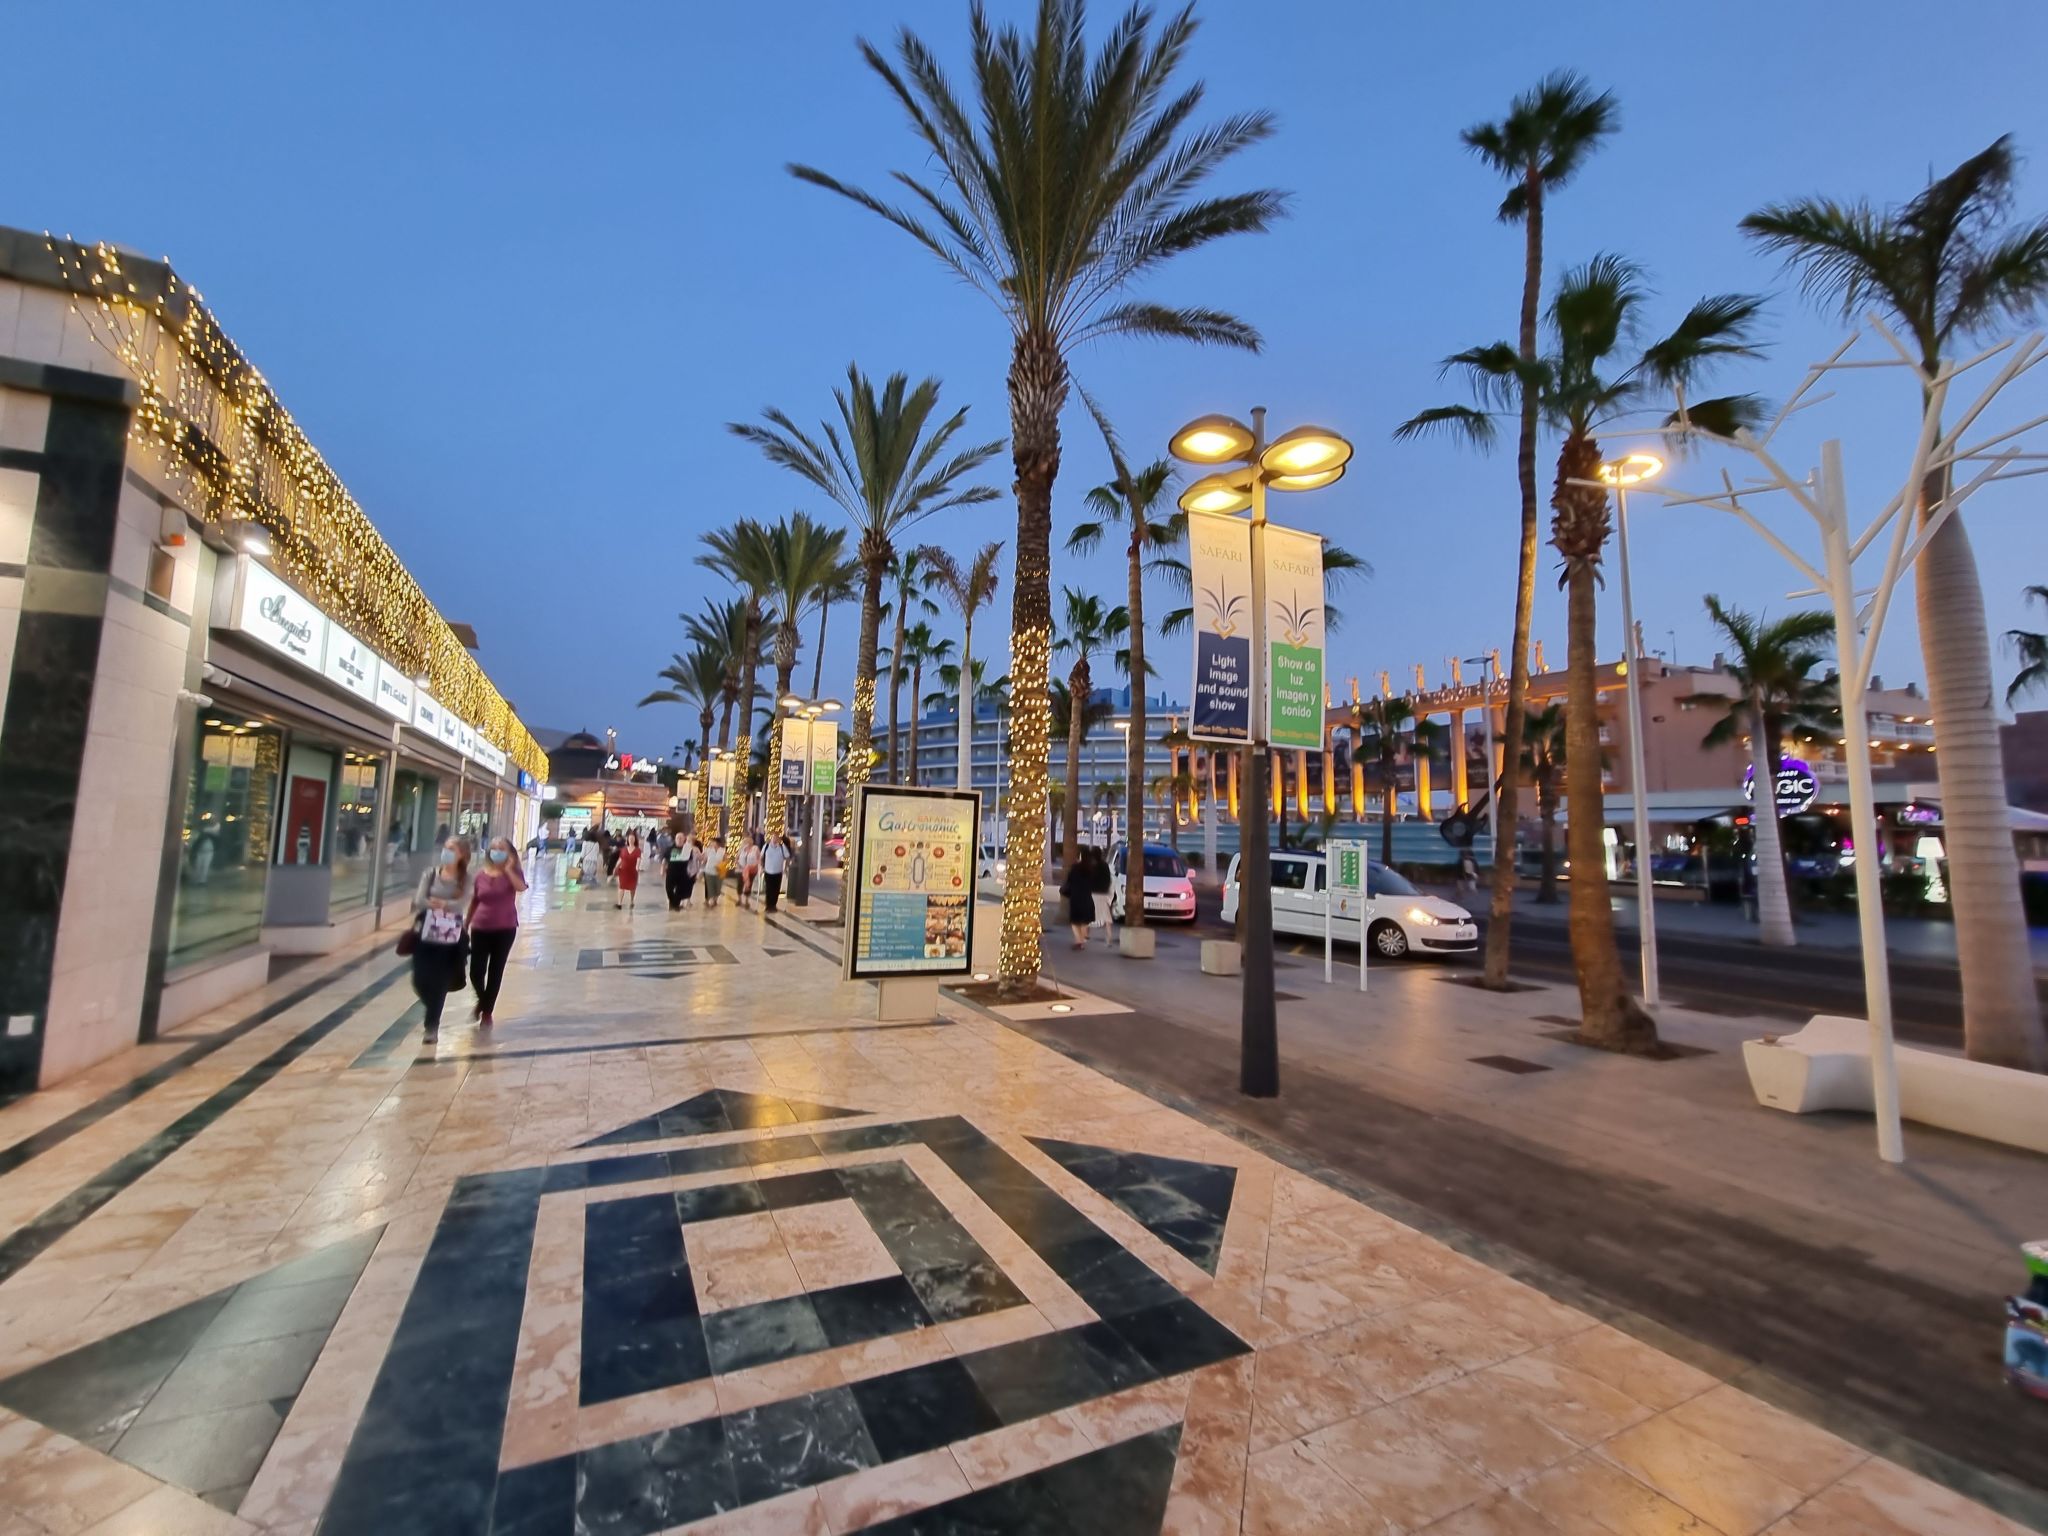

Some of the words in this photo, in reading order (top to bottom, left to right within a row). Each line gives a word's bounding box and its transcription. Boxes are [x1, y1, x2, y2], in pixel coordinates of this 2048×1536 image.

[1199, 544, 1242, 562] SAFARI
[1273, 559, 1315, 577] SAFARI
[1212, 653, 1237, 669] Light
[1278, 655, 1303, 670] Show
[1304, 660, 1316, 672] de
[1290, 672, 1304, 686] luz
[1198, 683, 1216, 694] and
[1219, 686, 1249, 699] sound
[1310, 693, 1317, 705] y
[1209, 698, 1236, 711] show
[1281, 704, 1312, 718] sonido
